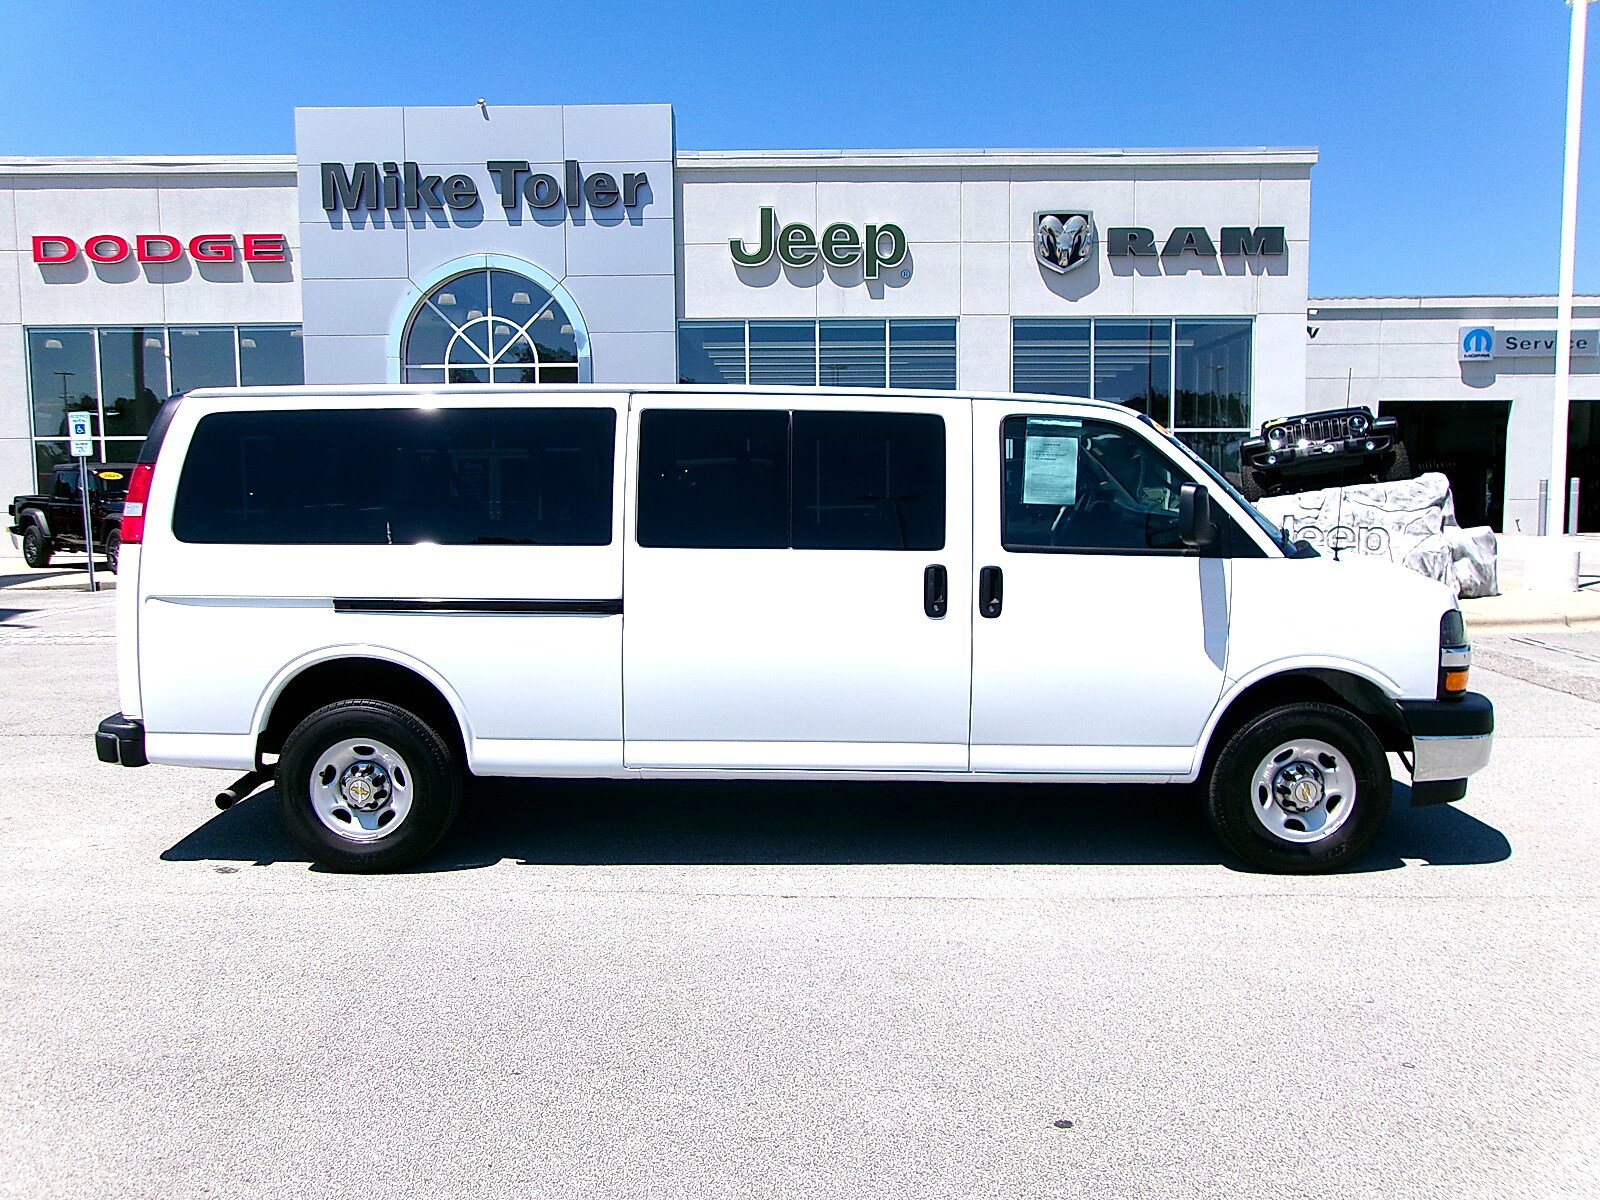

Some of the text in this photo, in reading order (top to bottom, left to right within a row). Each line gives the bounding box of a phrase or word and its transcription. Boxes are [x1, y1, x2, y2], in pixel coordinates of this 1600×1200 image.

[320, 159, 648, 210] Mike Toler
[32, 234, 286, 263] DODGE
[728, 206, 908, 279] Jeep
[1107, 227, 1285, 256] RAM
[1505, 336, 1588, 350] Serve
